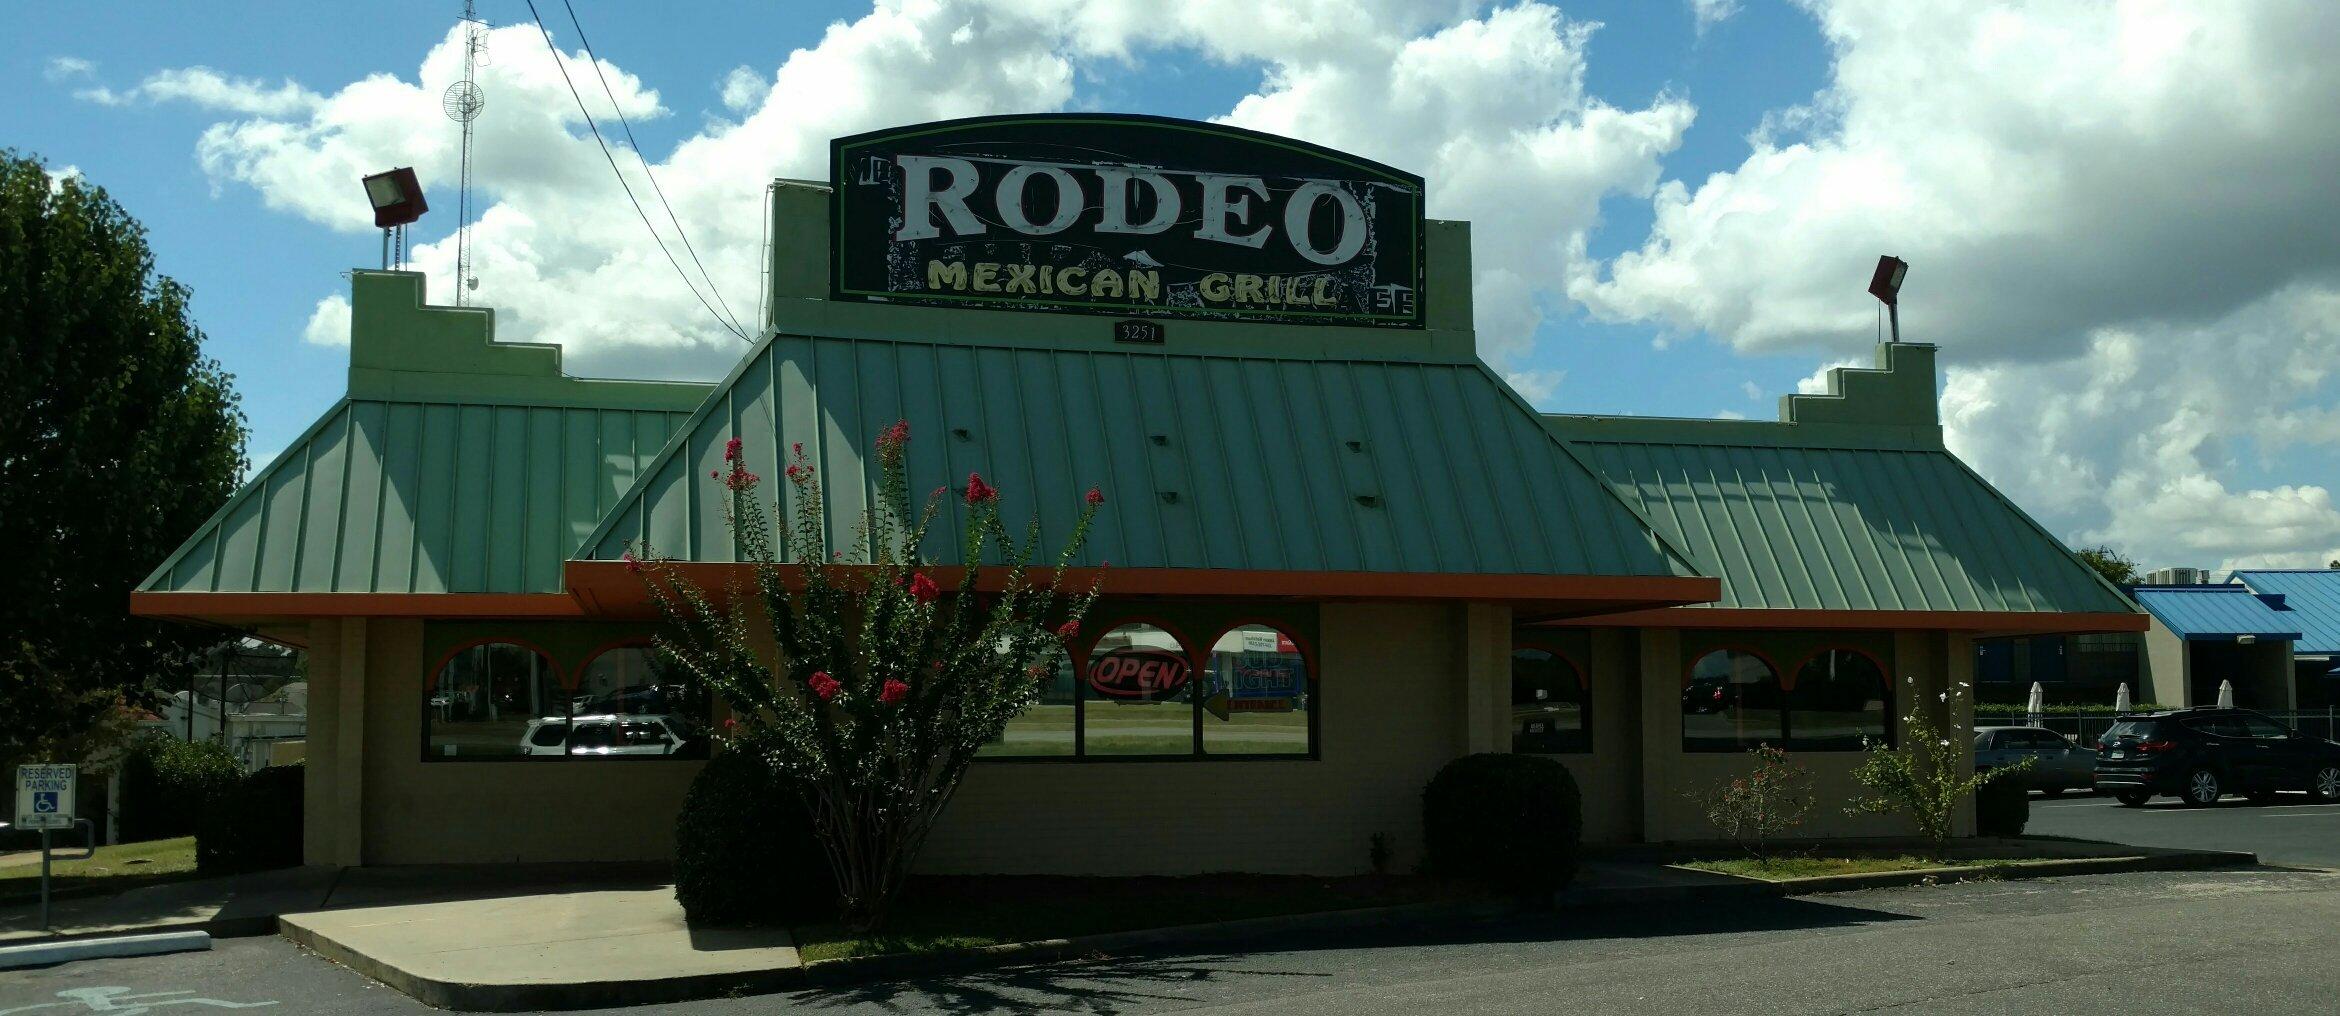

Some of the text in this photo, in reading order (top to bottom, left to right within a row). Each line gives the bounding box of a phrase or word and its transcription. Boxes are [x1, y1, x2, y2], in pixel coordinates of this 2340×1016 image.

[897, 155, 1368, 265] RODEO
[927, 259, 1160, 299] MEXICAN
[1200, 273, 1337, 306] GRILL
[1122, 324, 1155, 341] 3251
[1096, 656, 1180, 690] OPEN
[21, 767, 71, 779] RESERVED
[25, 780, 67, 791] PARKING
